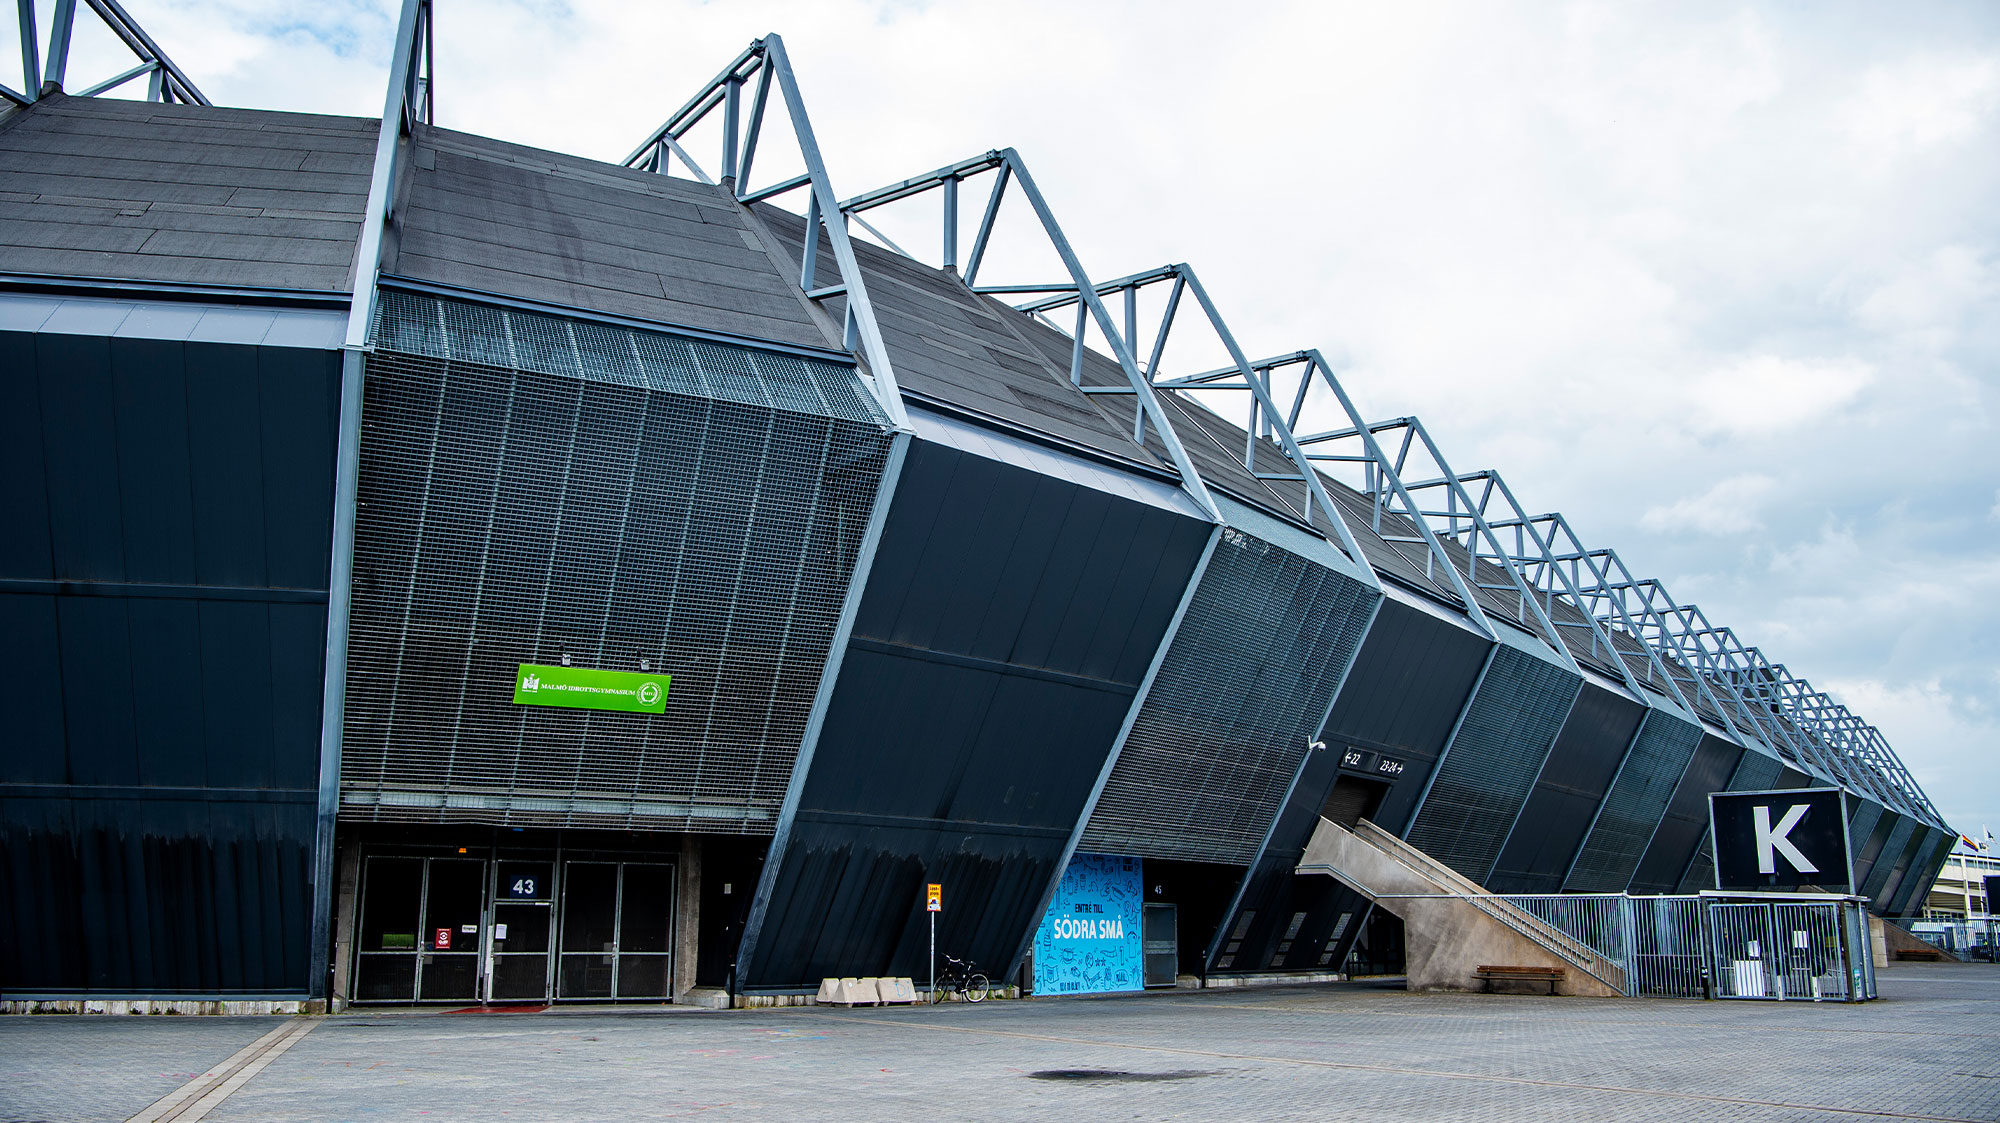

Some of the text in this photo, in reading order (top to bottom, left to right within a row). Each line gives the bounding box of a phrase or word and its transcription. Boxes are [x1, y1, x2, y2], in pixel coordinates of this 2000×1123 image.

[541, 683, 567, 691] MALMÖ
[568, 686, 636, 696] IDROTTSGYMNASIUM
[1350, 753, 1361, 765] 22
[1379, 760, 1398, 773] 23-24
[1753, 803, 1820, 874] K
[513, 879, 534, 894] 43
[1154, 885, 1162, 894] 45
[1075, 901, 1104, 913] ENTRÉ TILL
[1054, 914, 1124, 939] SÖDRA SMÅ
